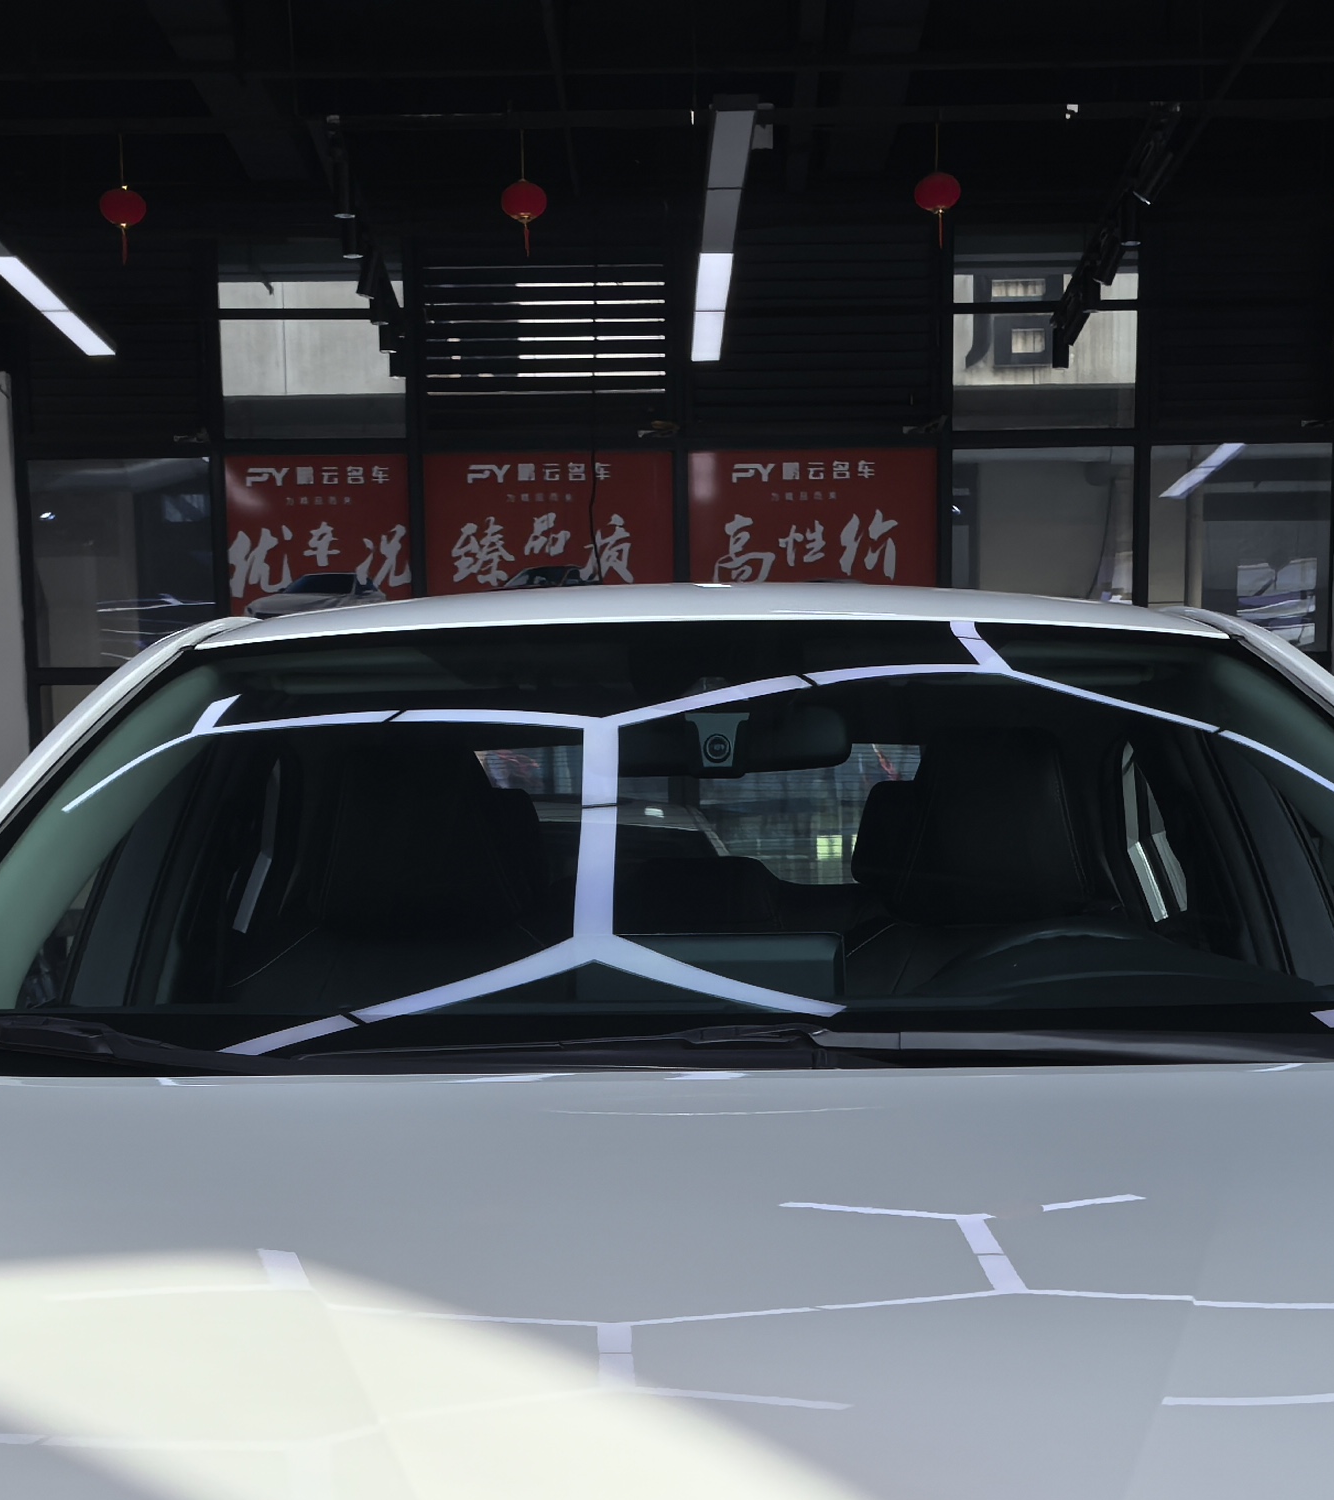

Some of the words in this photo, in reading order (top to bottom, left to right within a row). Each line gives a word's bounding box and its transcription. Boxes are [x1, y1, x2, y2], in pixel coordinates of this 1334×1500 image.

[245, 467, 290, 487] PY
[467, 464, 511, 484] PY
[731, 463, 776, 483] PY
